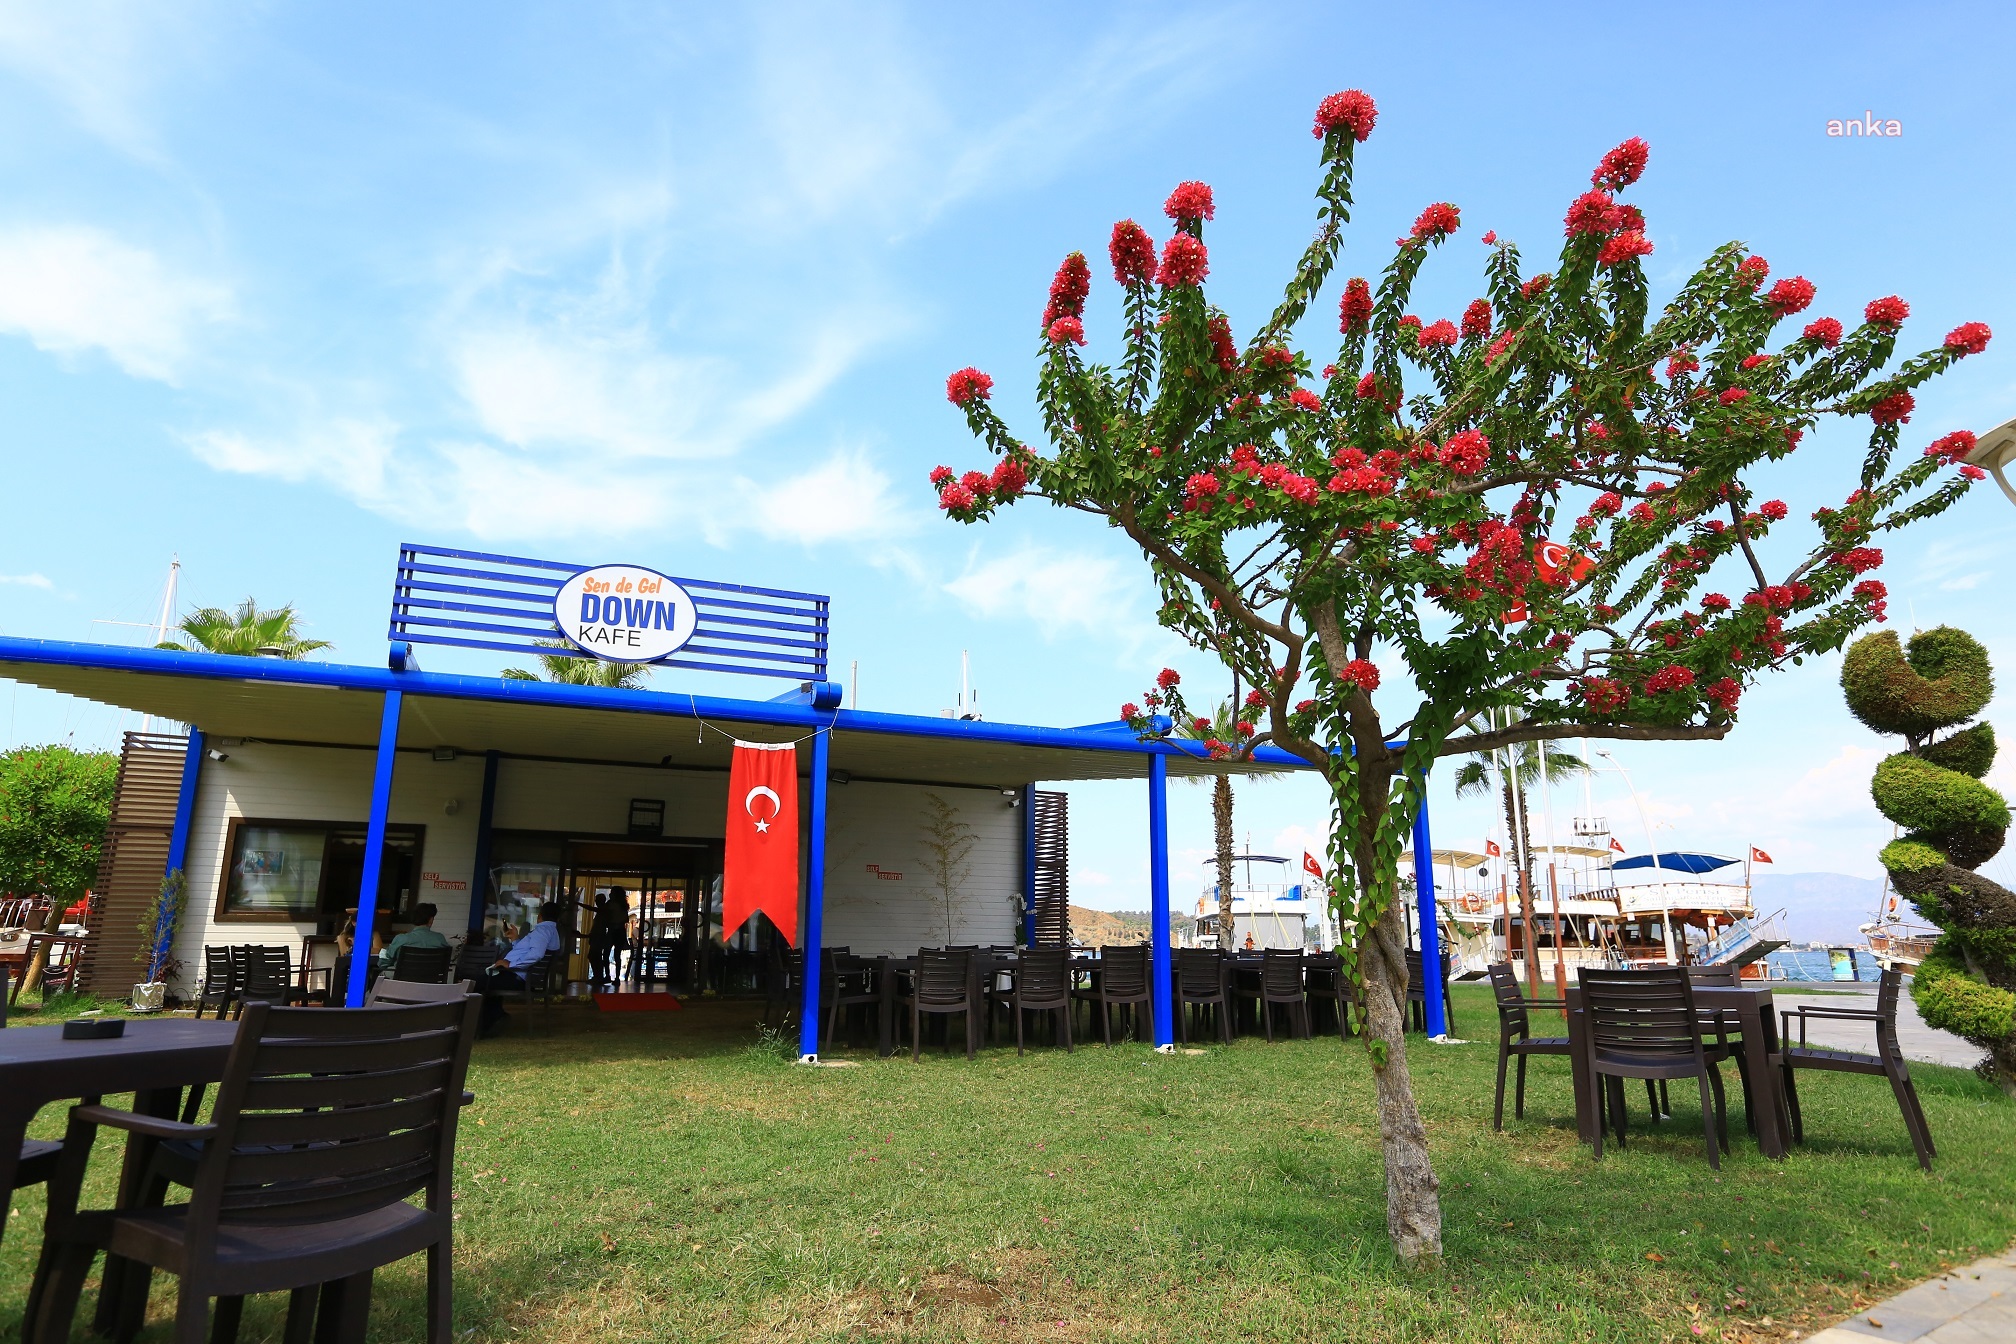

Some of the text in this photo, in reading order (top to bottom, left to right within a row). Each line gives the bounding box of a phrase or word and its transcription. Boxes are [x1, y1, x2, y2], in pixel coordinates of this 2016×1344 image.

[583, 576, 662, 594] Sen de Gel
[580, 593, 676, 631] DOWN
[578, 625, 642, 647] KAFE
[424, 872, 439, 880] SELF
